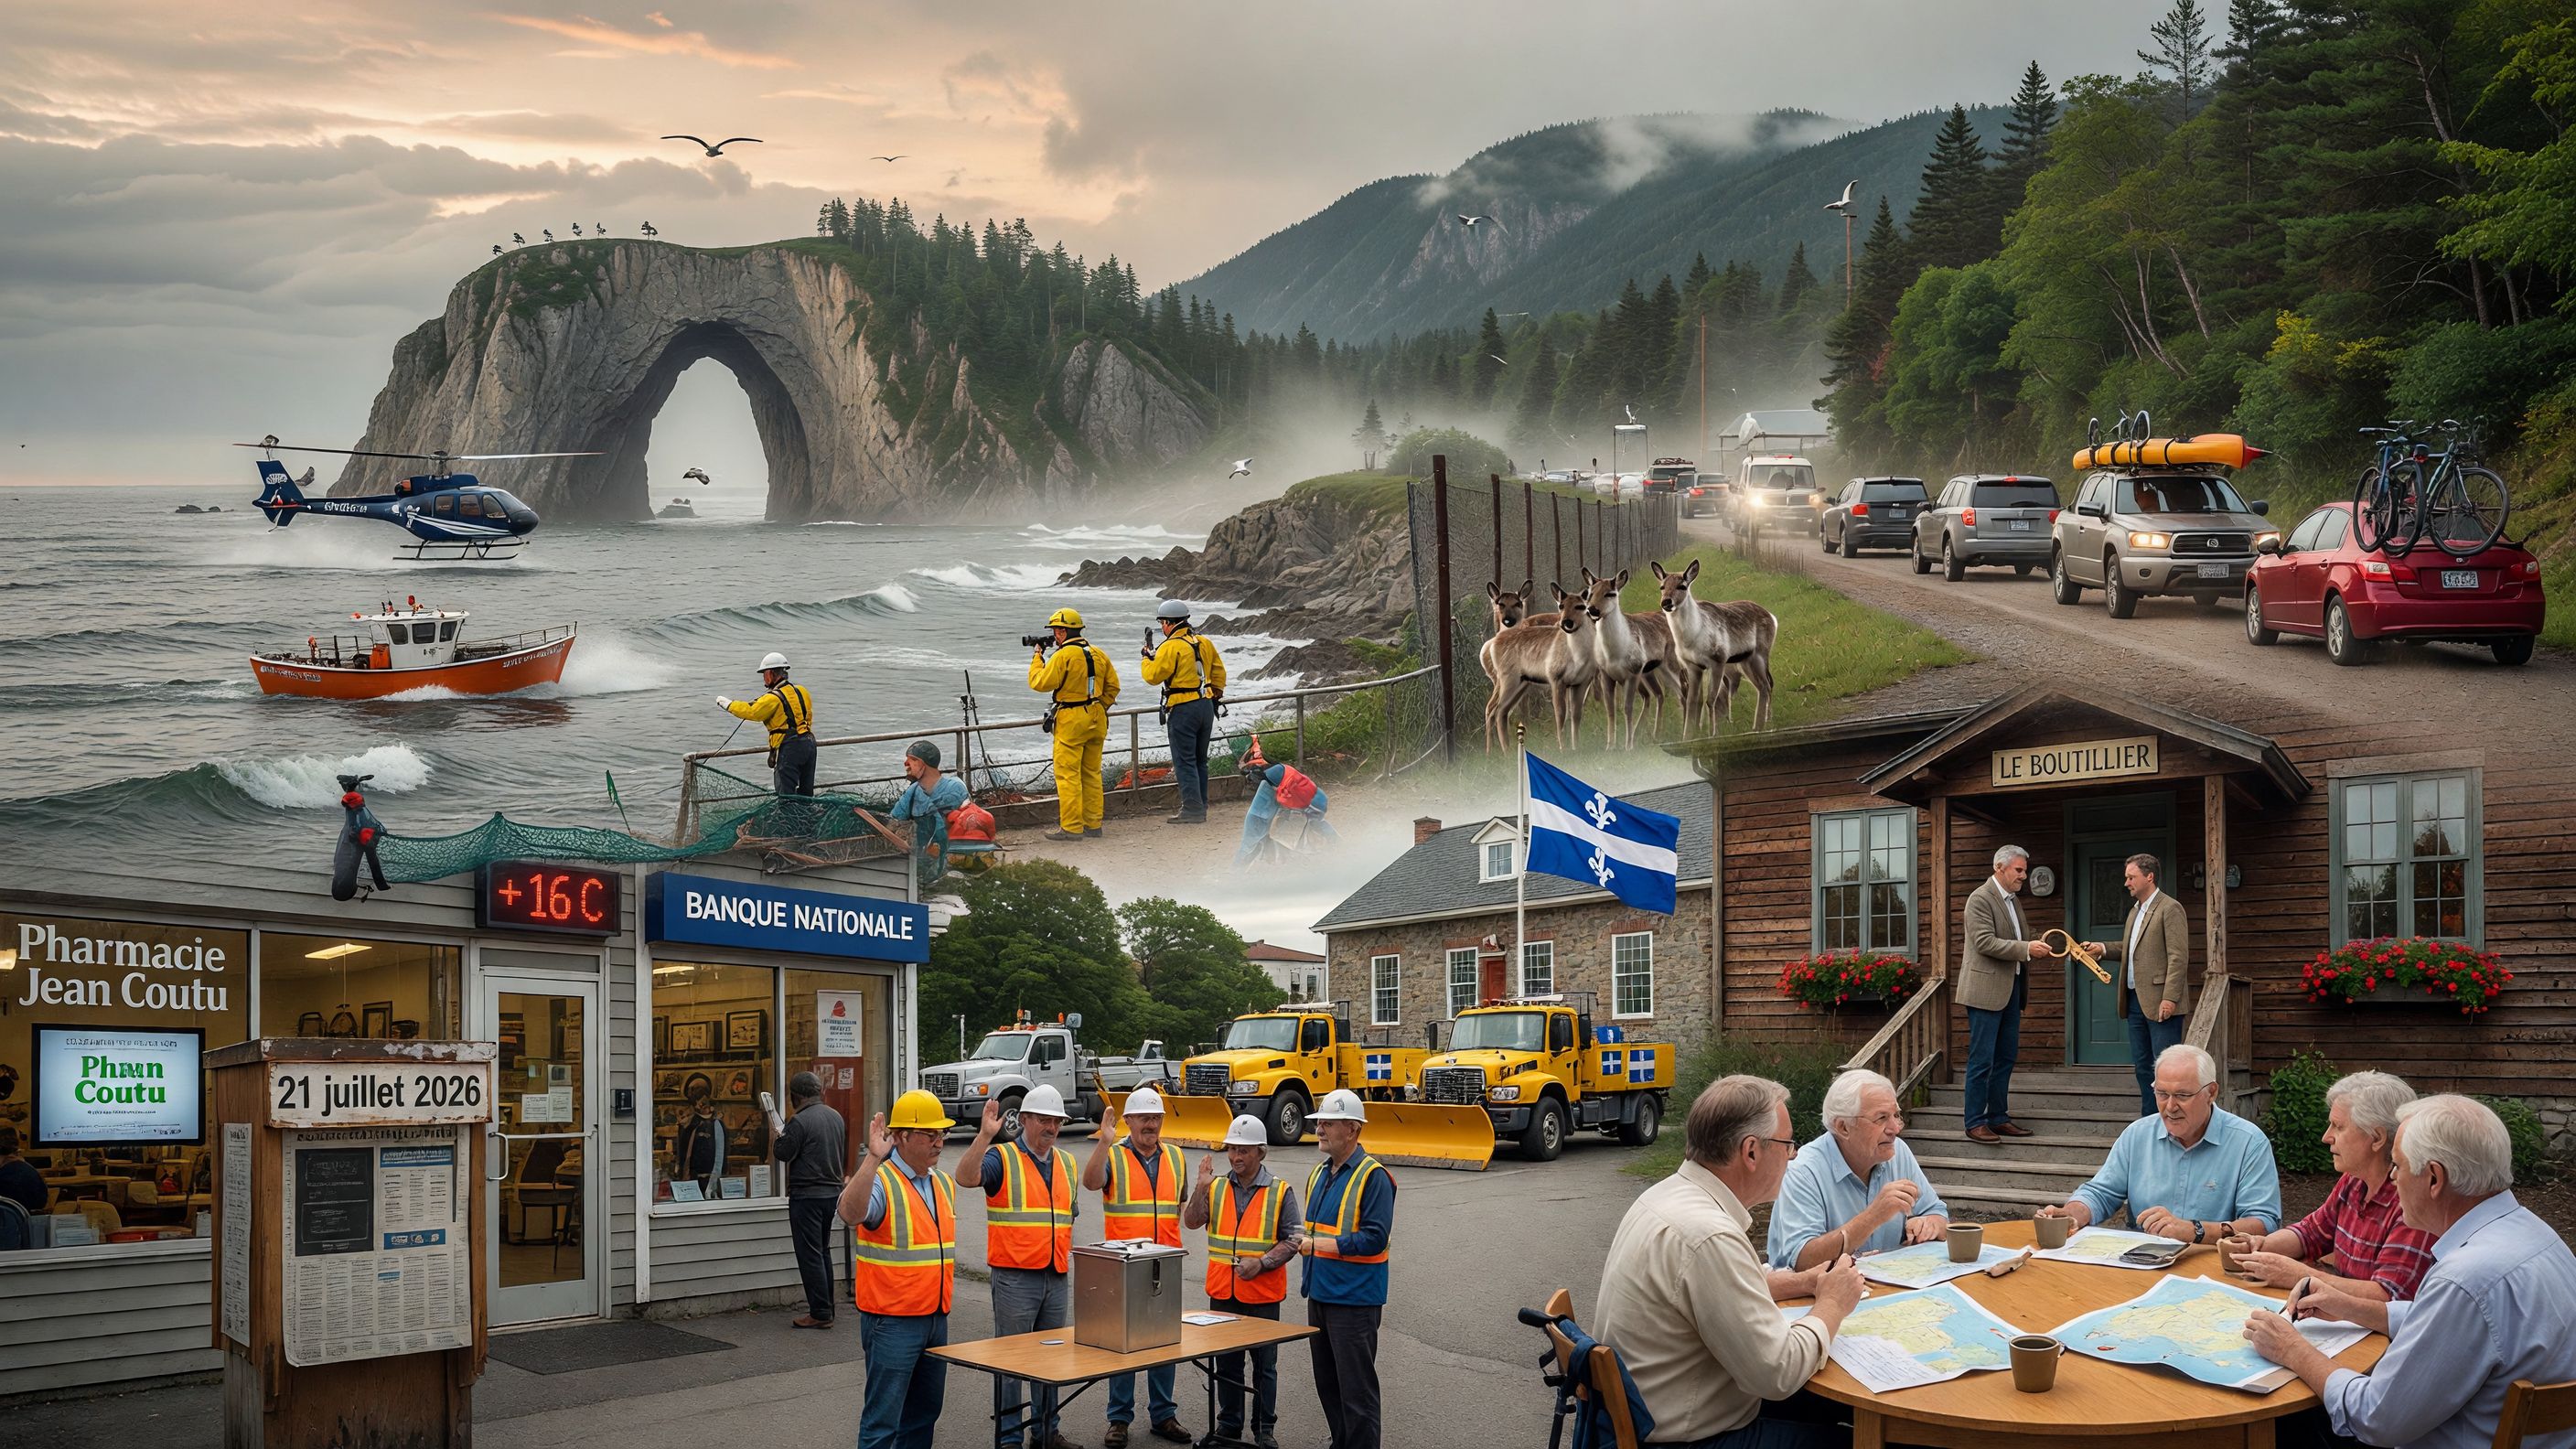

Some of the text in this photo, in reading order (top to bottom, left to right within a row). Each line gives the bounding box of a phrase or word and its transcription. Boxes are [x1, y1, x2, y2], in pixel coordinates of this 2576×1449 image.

[2001, 744, 2151, 778] LE BOUTILLIER
[686, 891, 914, 940] BANQUE NATIONALE
[17, 923, 226, 972] Pharmacie
[18, 967, 229, 1012] Jean Coutu
[74, 1079, 166, 1104] Coutu
[277, 1074, 481, 1117] 21 juillet 2026
